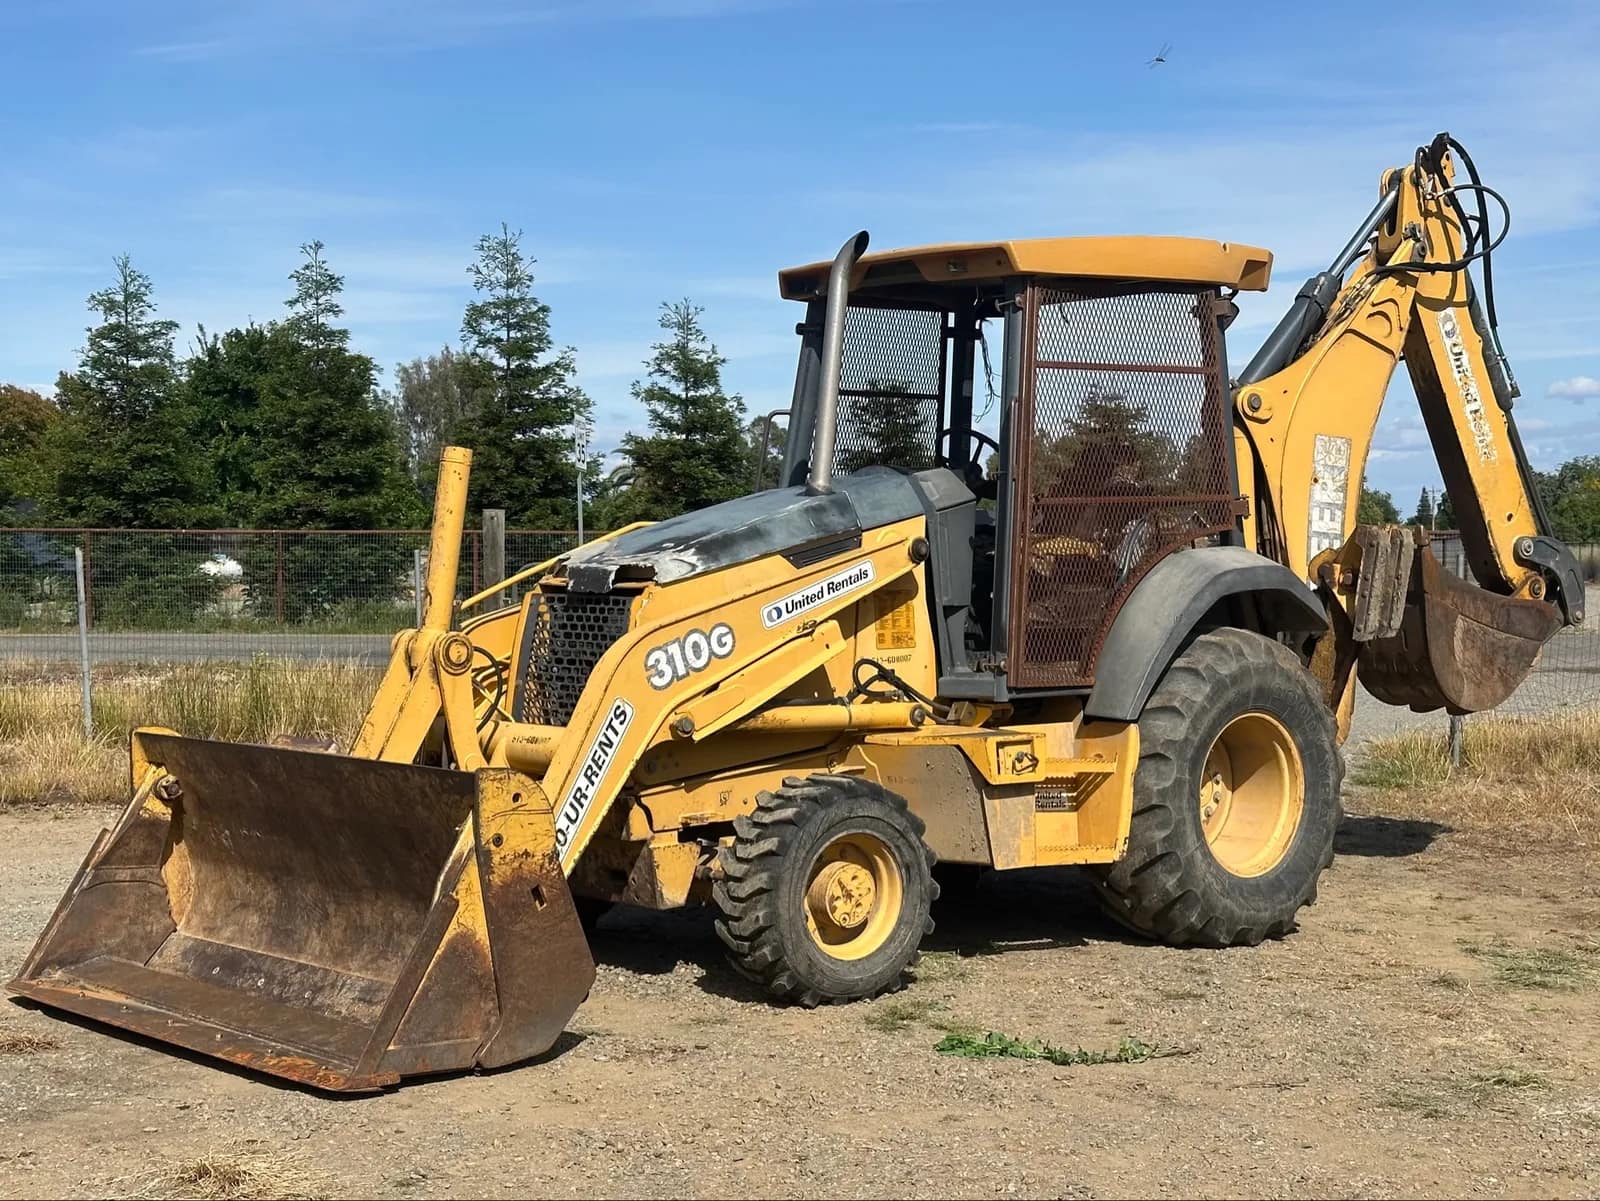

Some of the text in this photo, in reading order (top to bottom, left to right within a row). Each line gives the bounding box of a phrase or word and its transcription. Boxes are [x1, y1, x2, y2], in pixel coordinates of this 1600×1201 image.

[576, 442, 586, 465] 35
[785, 567, 869, 614] United Rentals
[645, 622, 736, 691] 310G
